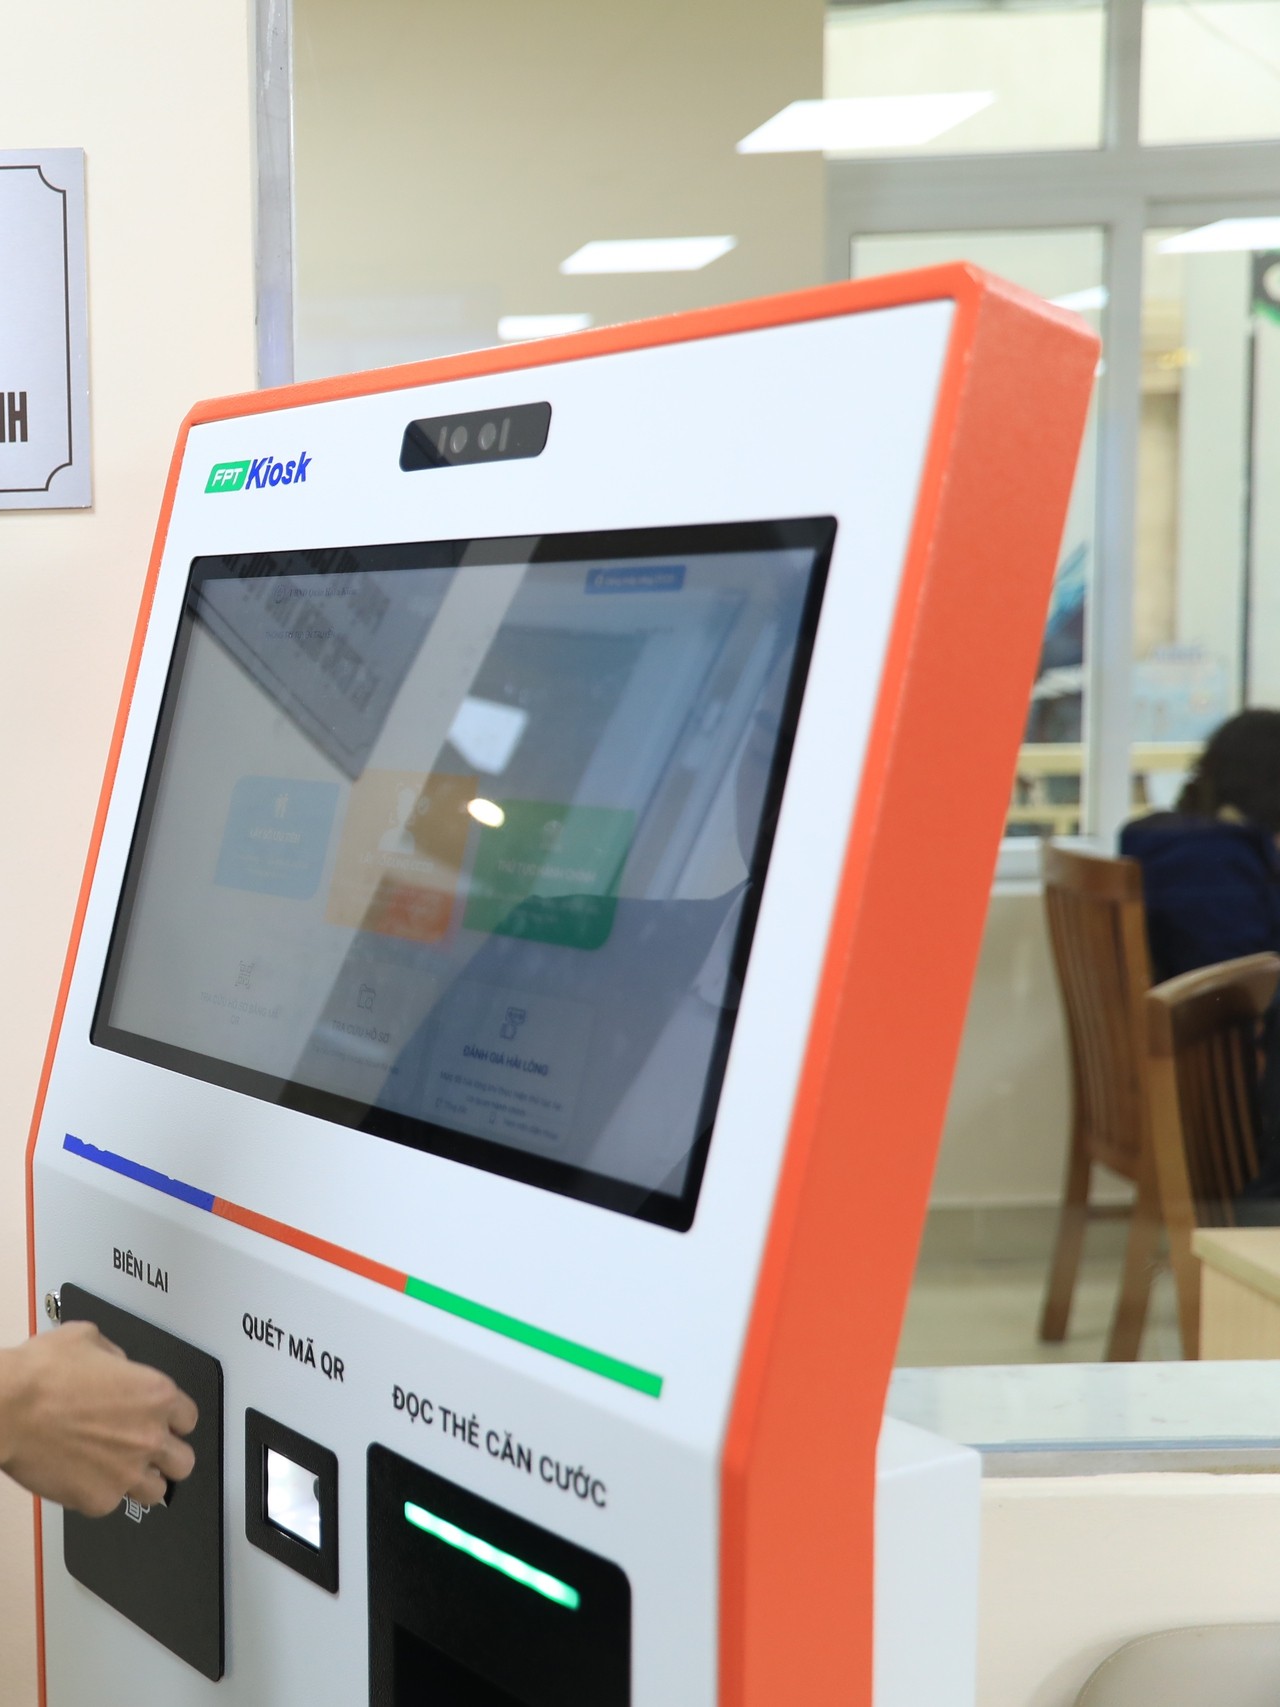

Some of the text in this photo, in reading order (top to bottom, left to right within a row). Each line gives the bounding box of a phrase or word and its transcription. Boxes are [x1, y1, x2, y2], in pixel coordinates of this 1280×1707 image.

[211, 451, 313, 490] FPT Kiosk
[463, 1043, 489, 1061] ĐÁNH
[489, 1051, 505, 1065] GIÁ
[113, 1248, 168, 1293] BIÊN LAI
[242, 1313, 345, 1382] QUÉT MÃ QR
[392, 1384, 607, 1508] ĐỌC THẺ CĂN CƯỚC
